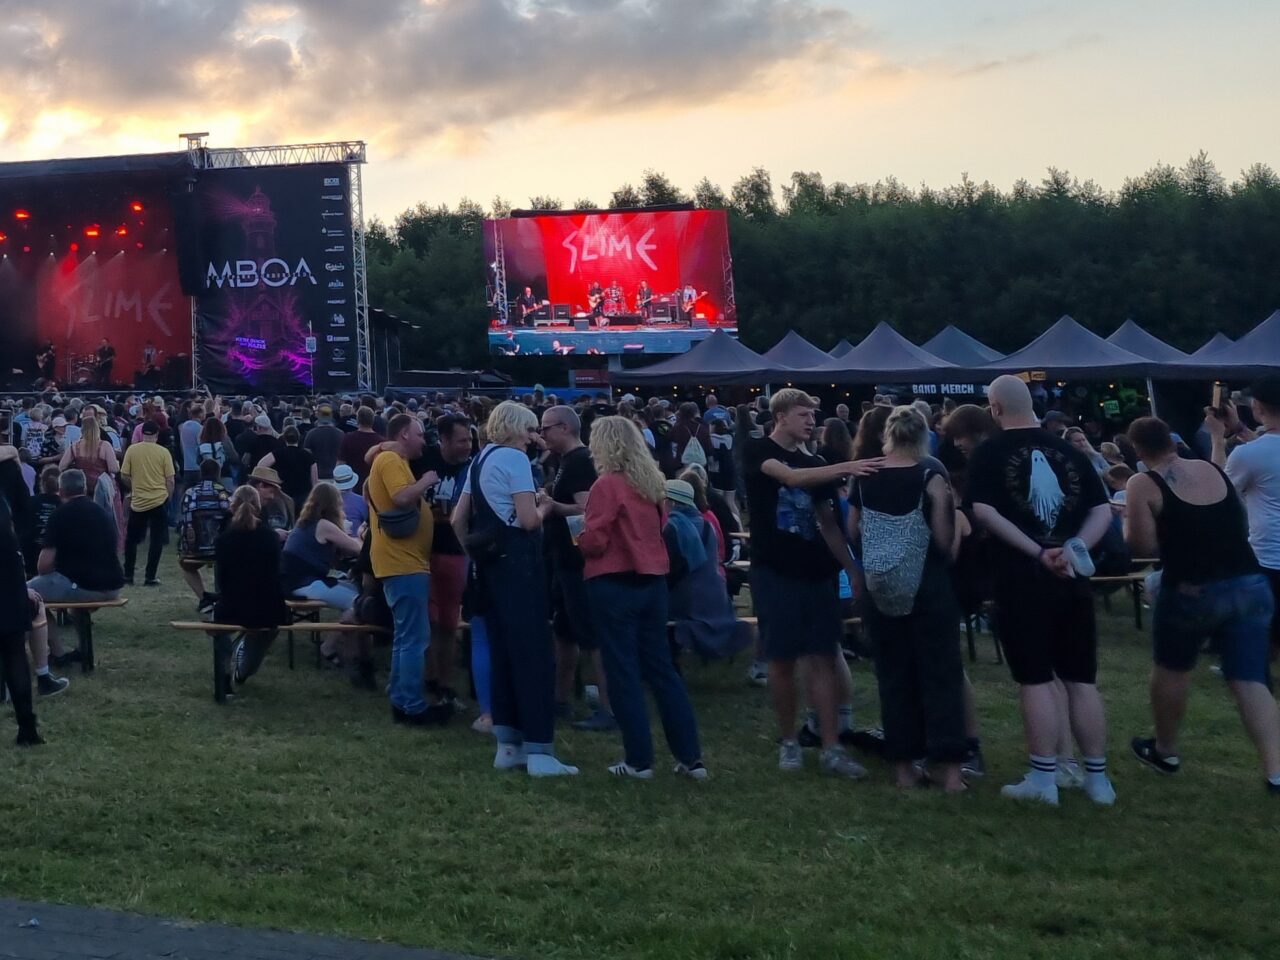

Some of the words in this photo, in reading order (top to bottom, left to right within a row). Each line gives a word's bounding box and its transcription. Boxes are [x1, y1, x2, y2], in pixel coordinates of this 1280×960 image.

[562, 227, 658, 274] SLIME
[206, 257, 318, 289] MBOA
[58, 281, 174, 339] SLIME
[912, 383, 937, 395] BAND
[940, 383, 975, 395] MERCH
